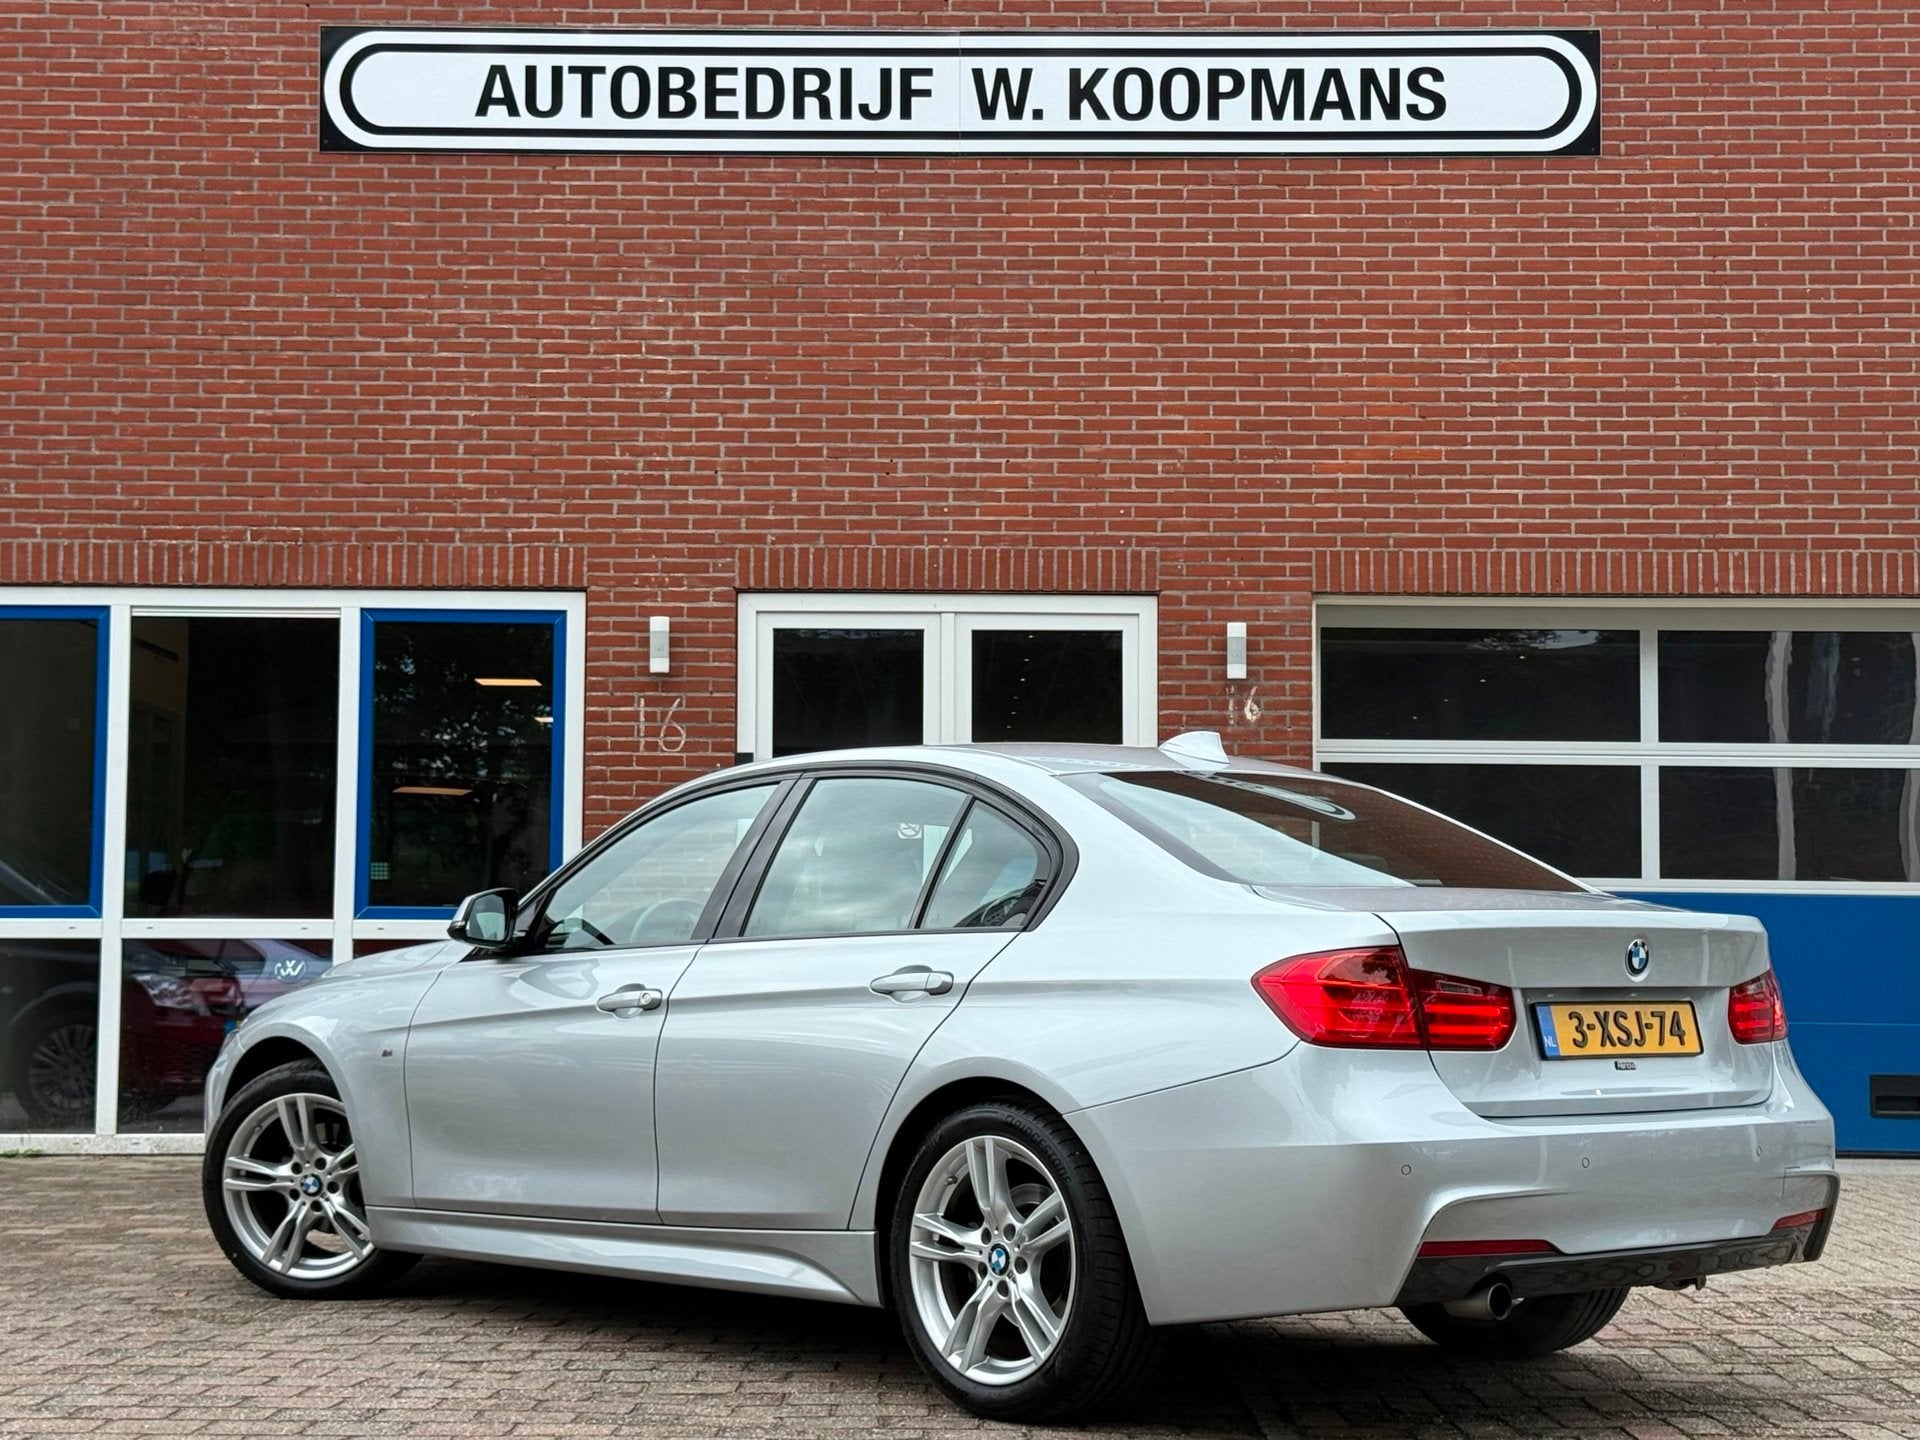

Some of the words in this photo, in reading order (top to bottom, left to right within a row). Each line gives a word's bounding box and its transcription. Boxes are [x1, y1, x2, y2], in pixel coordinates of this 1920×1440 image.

[475, 64, 933, 121] AUTOBEDRIJF
[971, 67, 1044, 121] W.
[1069, 66, 1447, 122] KOOPMANS
[639, 697, 687, 753] 16
[1226, 685, 1262, 725] 16
[1544, 1036, 1557, 1048] NL
[1568, 1010, 1686, 1048] 3-XSJ-74
